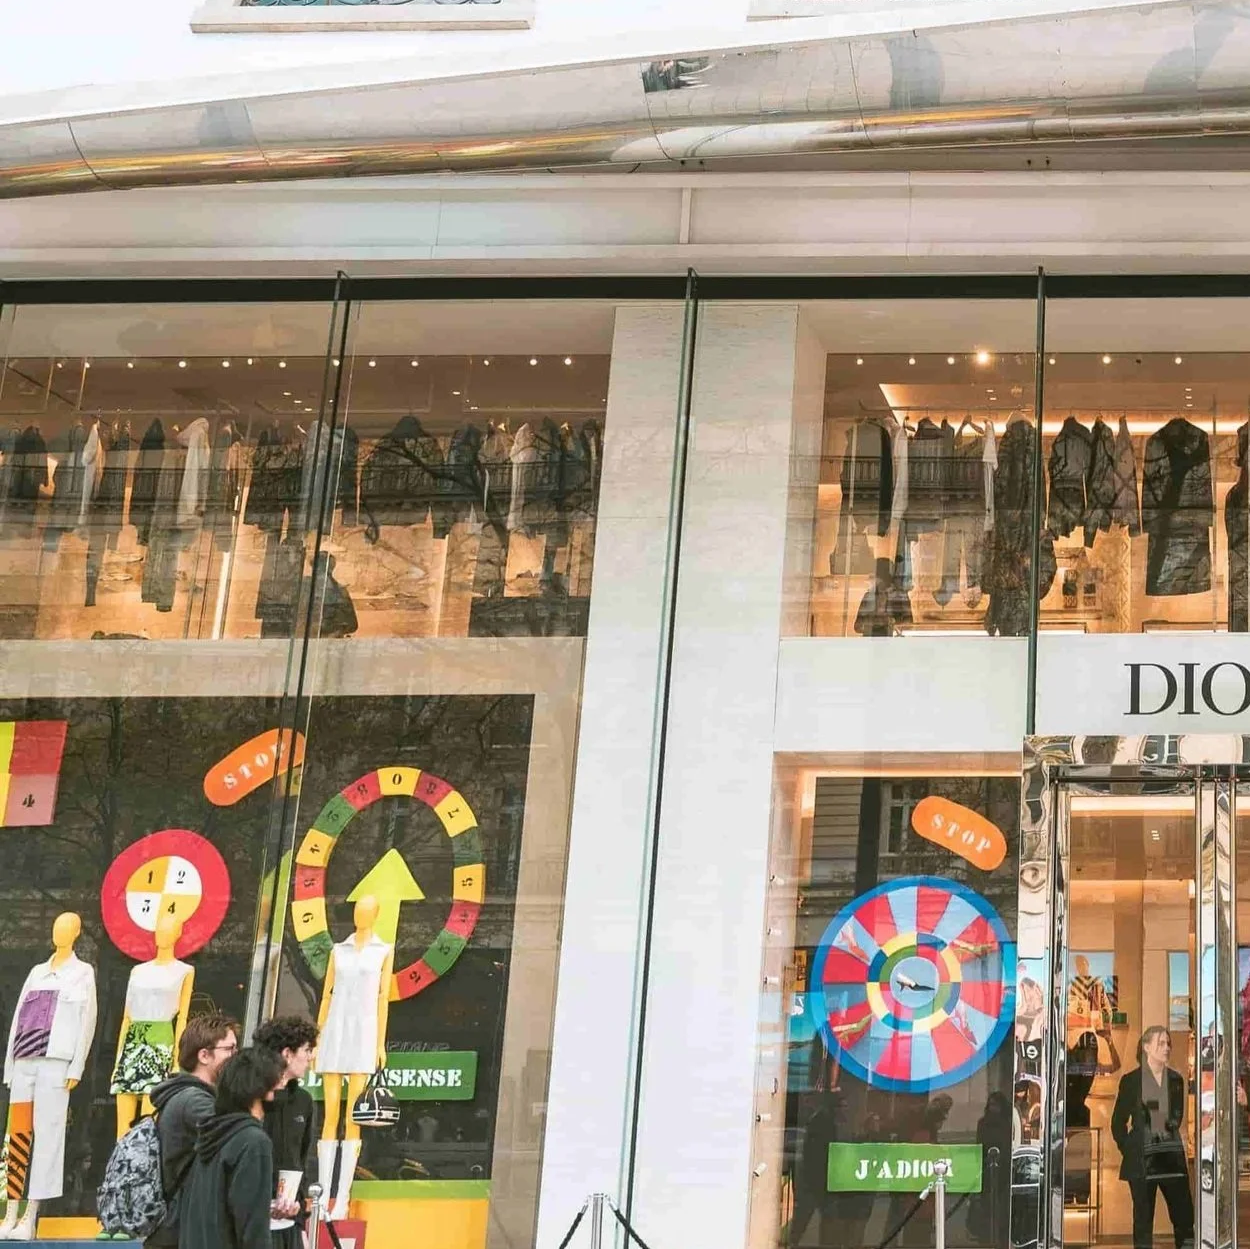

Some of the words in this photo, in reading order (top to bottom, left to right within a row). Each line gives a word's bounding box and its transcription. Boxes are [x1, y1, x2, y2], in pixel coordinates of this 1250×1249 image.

[223, 742, 286, 789] STOP
[931, 813, 991, 853] STOP
[147, 870, 153, 884] 1
